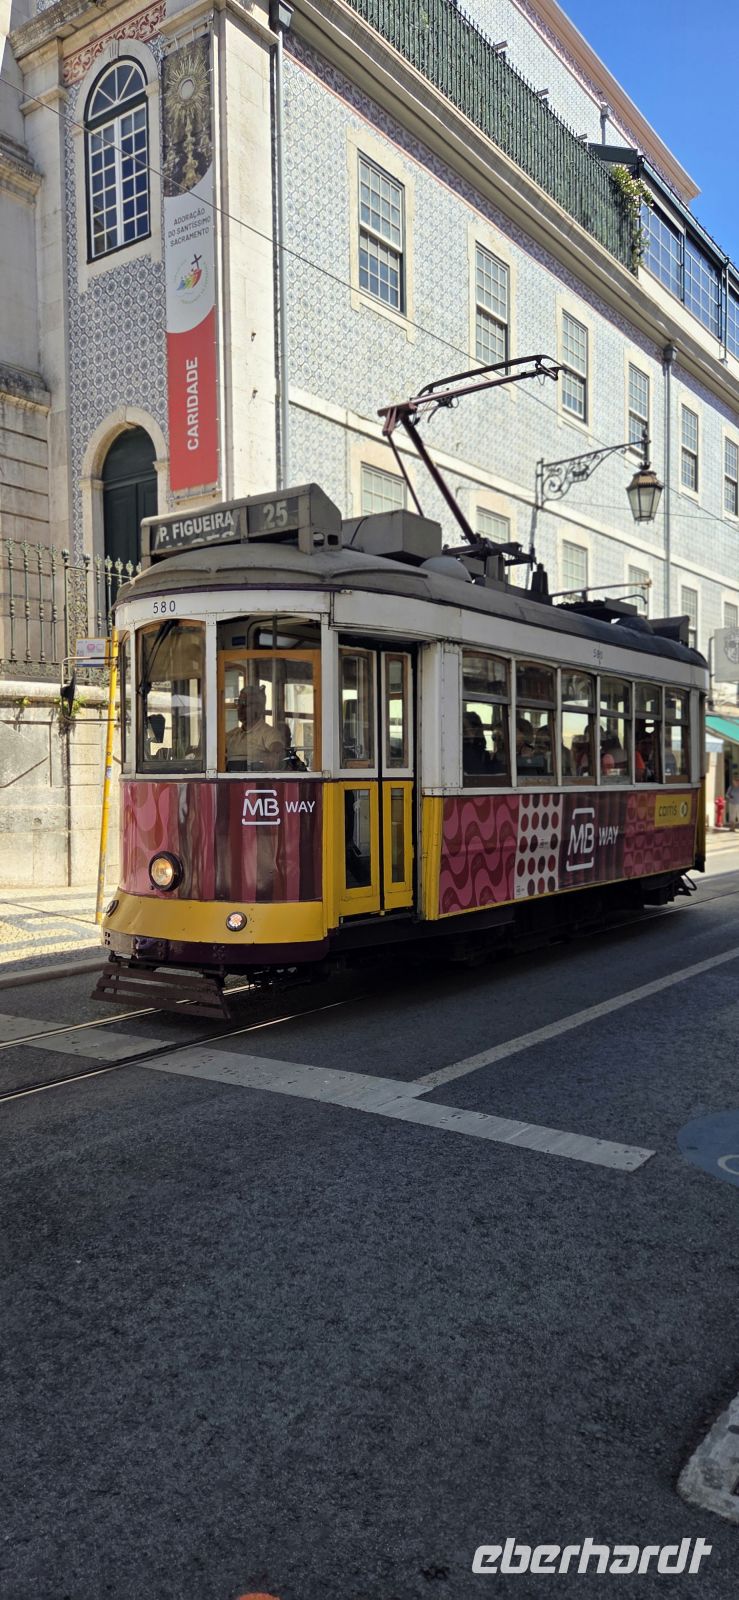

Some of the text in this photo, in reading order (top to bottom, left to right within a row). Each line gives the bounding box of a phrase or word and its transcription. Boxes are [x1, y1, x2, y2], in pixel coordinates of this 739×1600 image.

[174, 208, 205, 226] ADORAÇÃO
[168, 229, 176, 238] DO
[170, 227, 209, 247] SACRAMENTO
[186, 357, 199, 450] CARIDADE
[263, 501, 288, 528] 25
[159, 525, 169, 542] P.
[172, 511, 235, 539] FIGUEIRA
[153, 600, 176, 614] 580
[242, 798, 315, 817] MB WAY
[568, 823, 595, 856] MB
[599, 825, 619, 846] WAY
